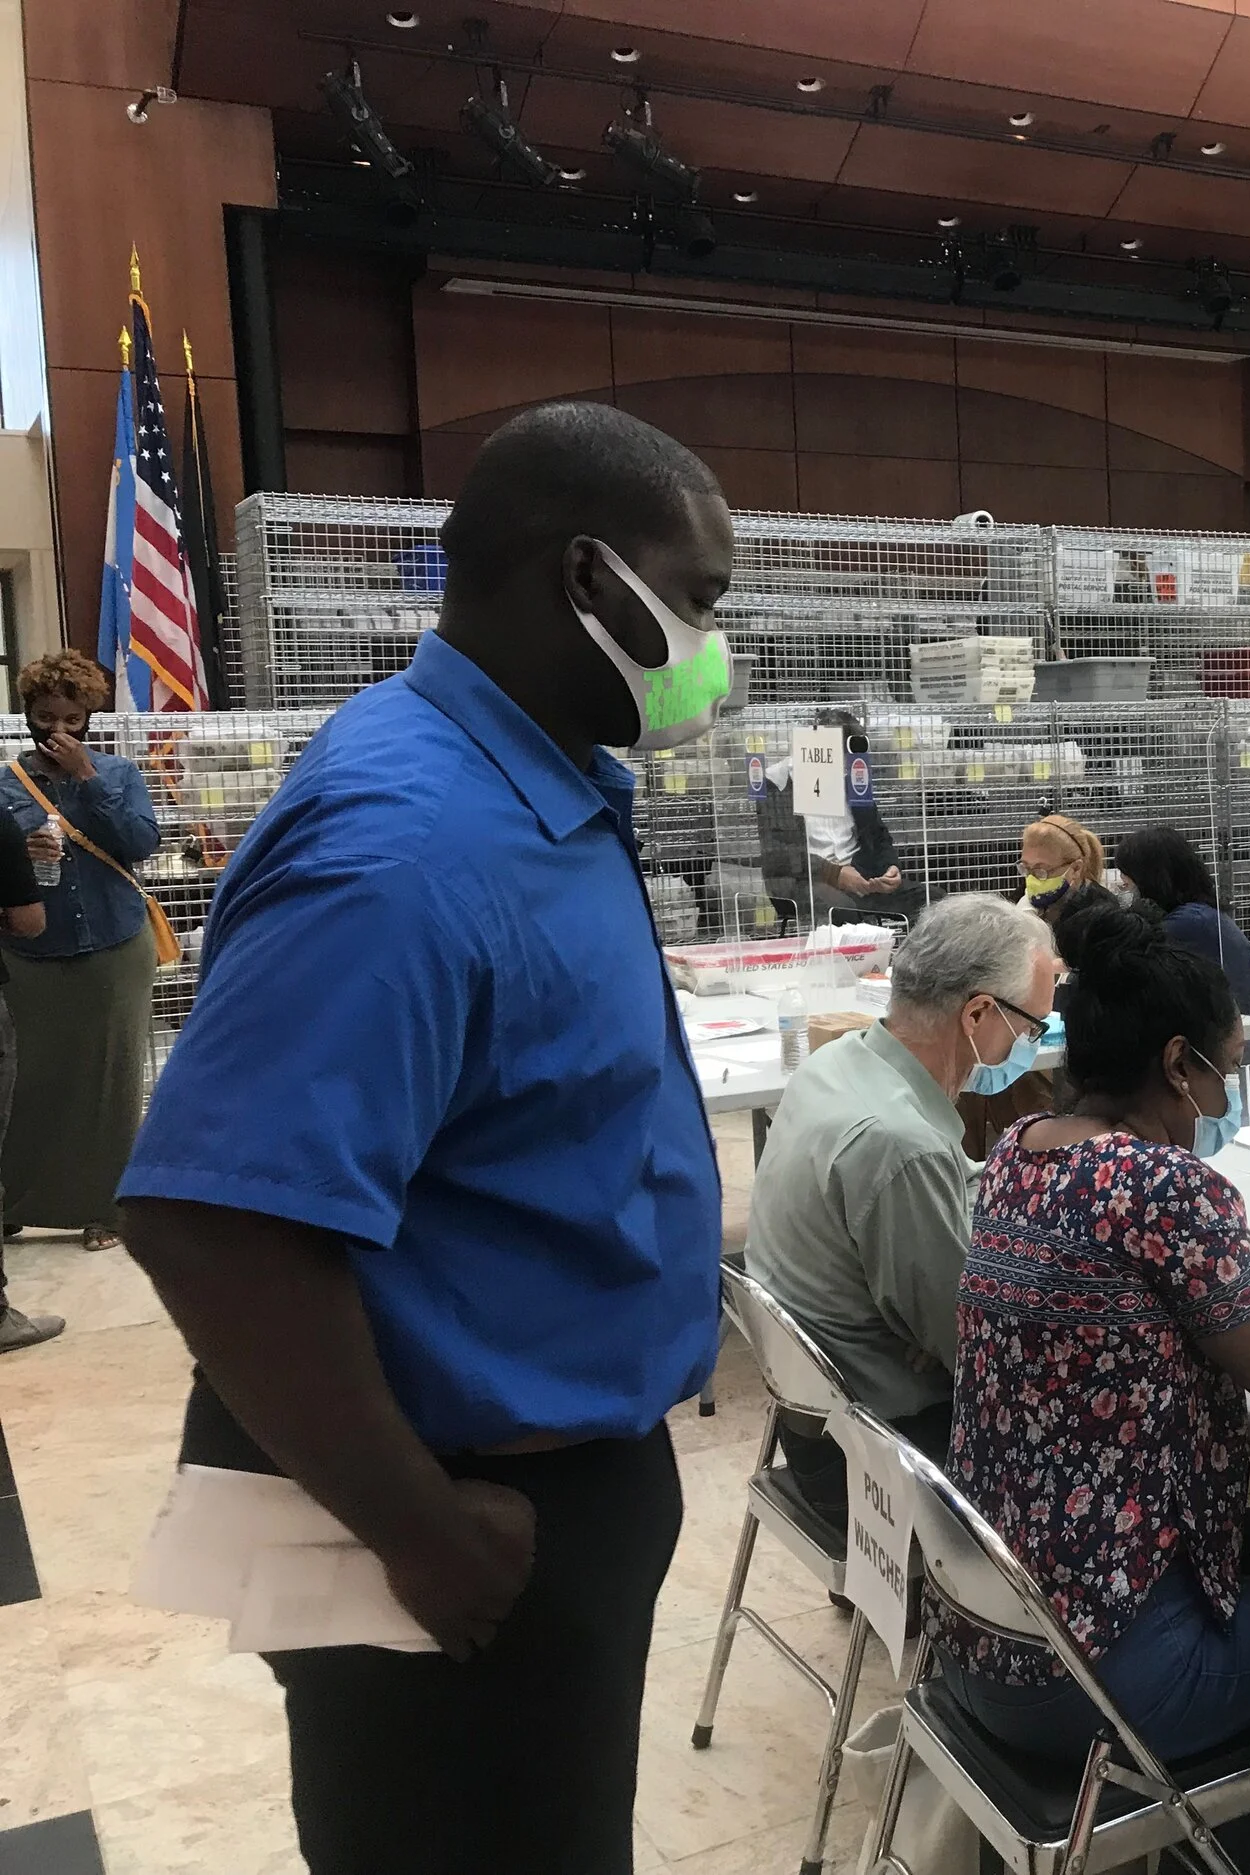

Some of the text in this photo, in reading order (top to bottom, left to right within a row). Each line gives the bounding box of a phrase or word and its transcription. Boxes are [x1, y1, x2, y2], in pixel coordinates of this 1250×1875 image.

[800, 747, 833, 763] TABLE
[813, 776, 820, 797] 4
[761, 961, 793, 971] STATES
[864, 1471, 895, 1527] POLL
[854, 1517, 906, 1608] WATCHER
